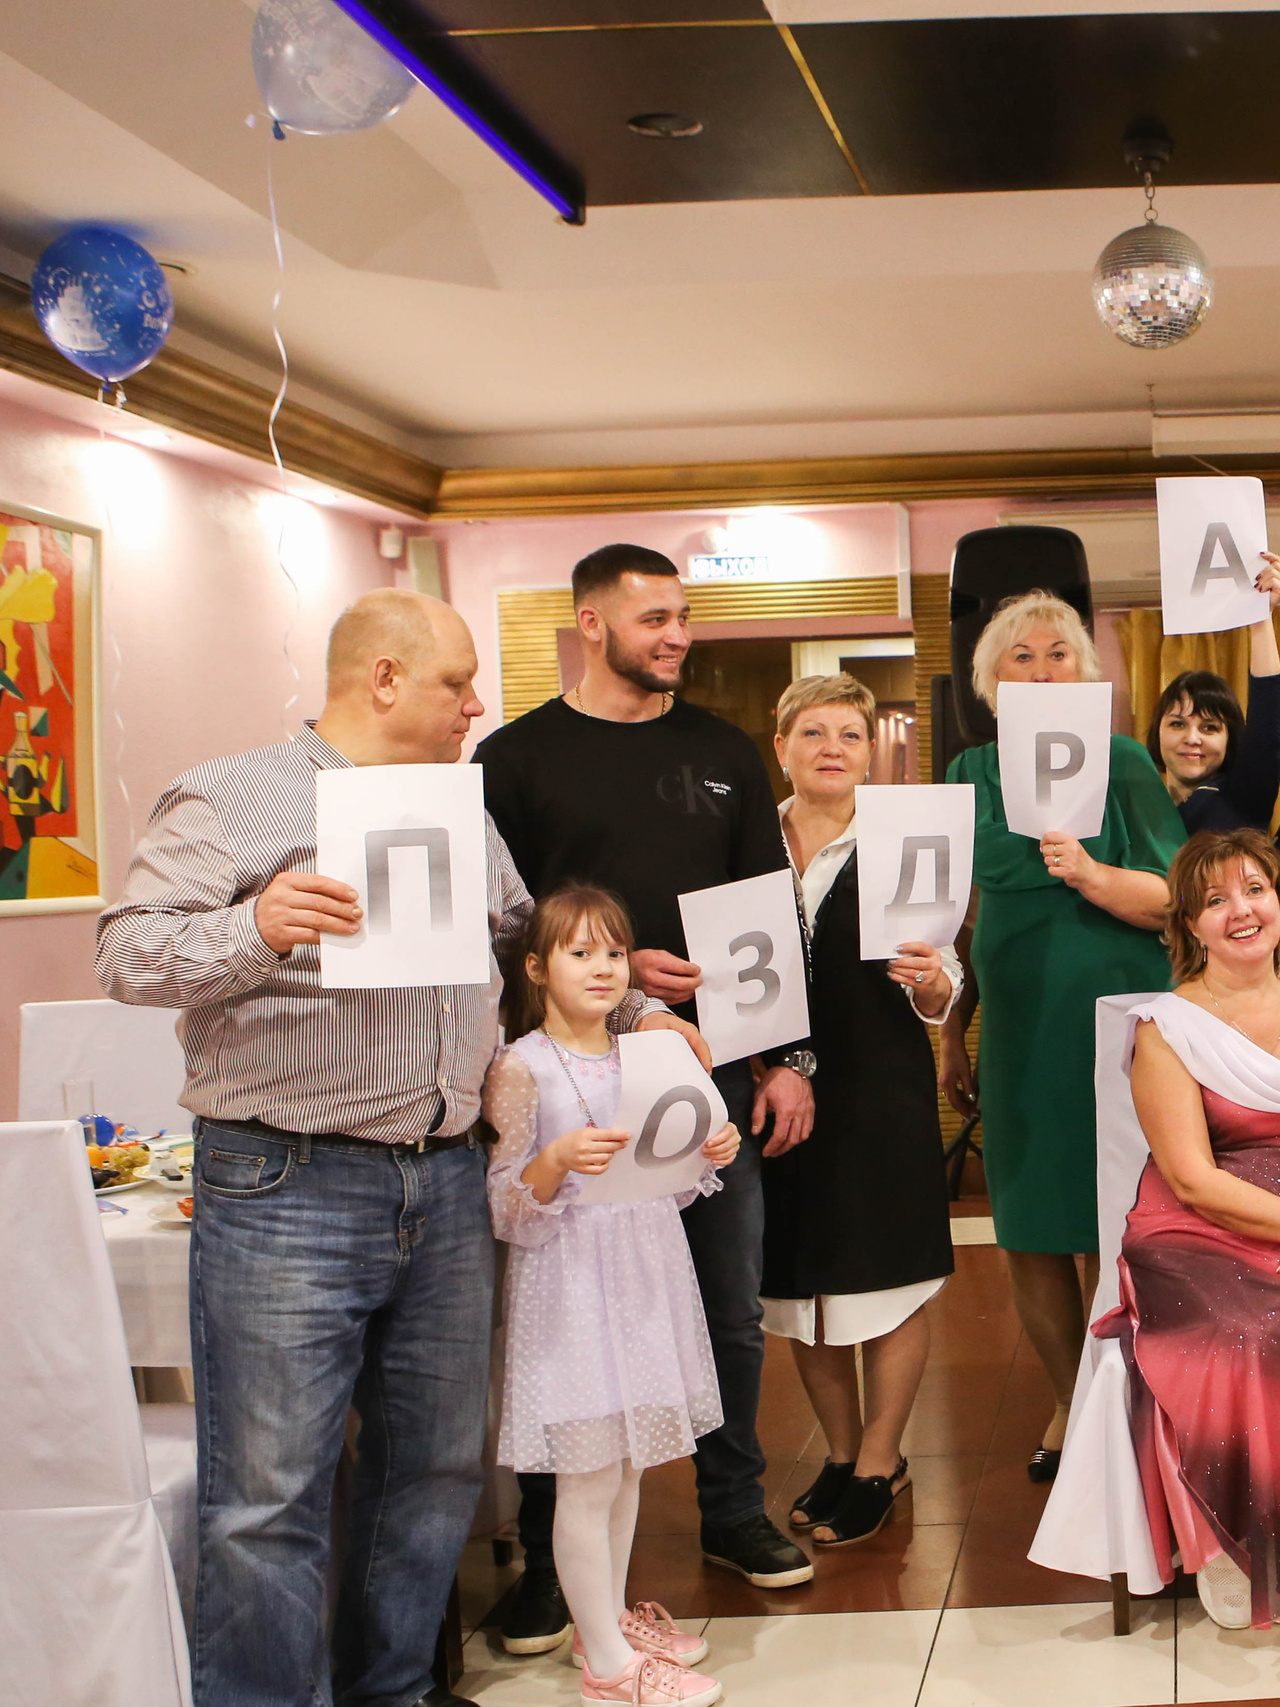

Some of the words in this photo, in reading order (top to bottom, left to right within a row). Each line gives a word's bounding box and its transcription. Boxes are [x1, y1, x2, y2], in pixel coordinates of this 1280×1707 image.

[1190, 522, 1252, 599] А
[704, 780, 721, 789] Calvin
[712, 787, 727, 796] Jeans
[1034, 731, 1086, 807] Р
[364, 827, 453, 937] П
[884, 835, 956, 926] Д
[728, 930, 782, 1017] З
[634, 1085, 713, 1170] О
